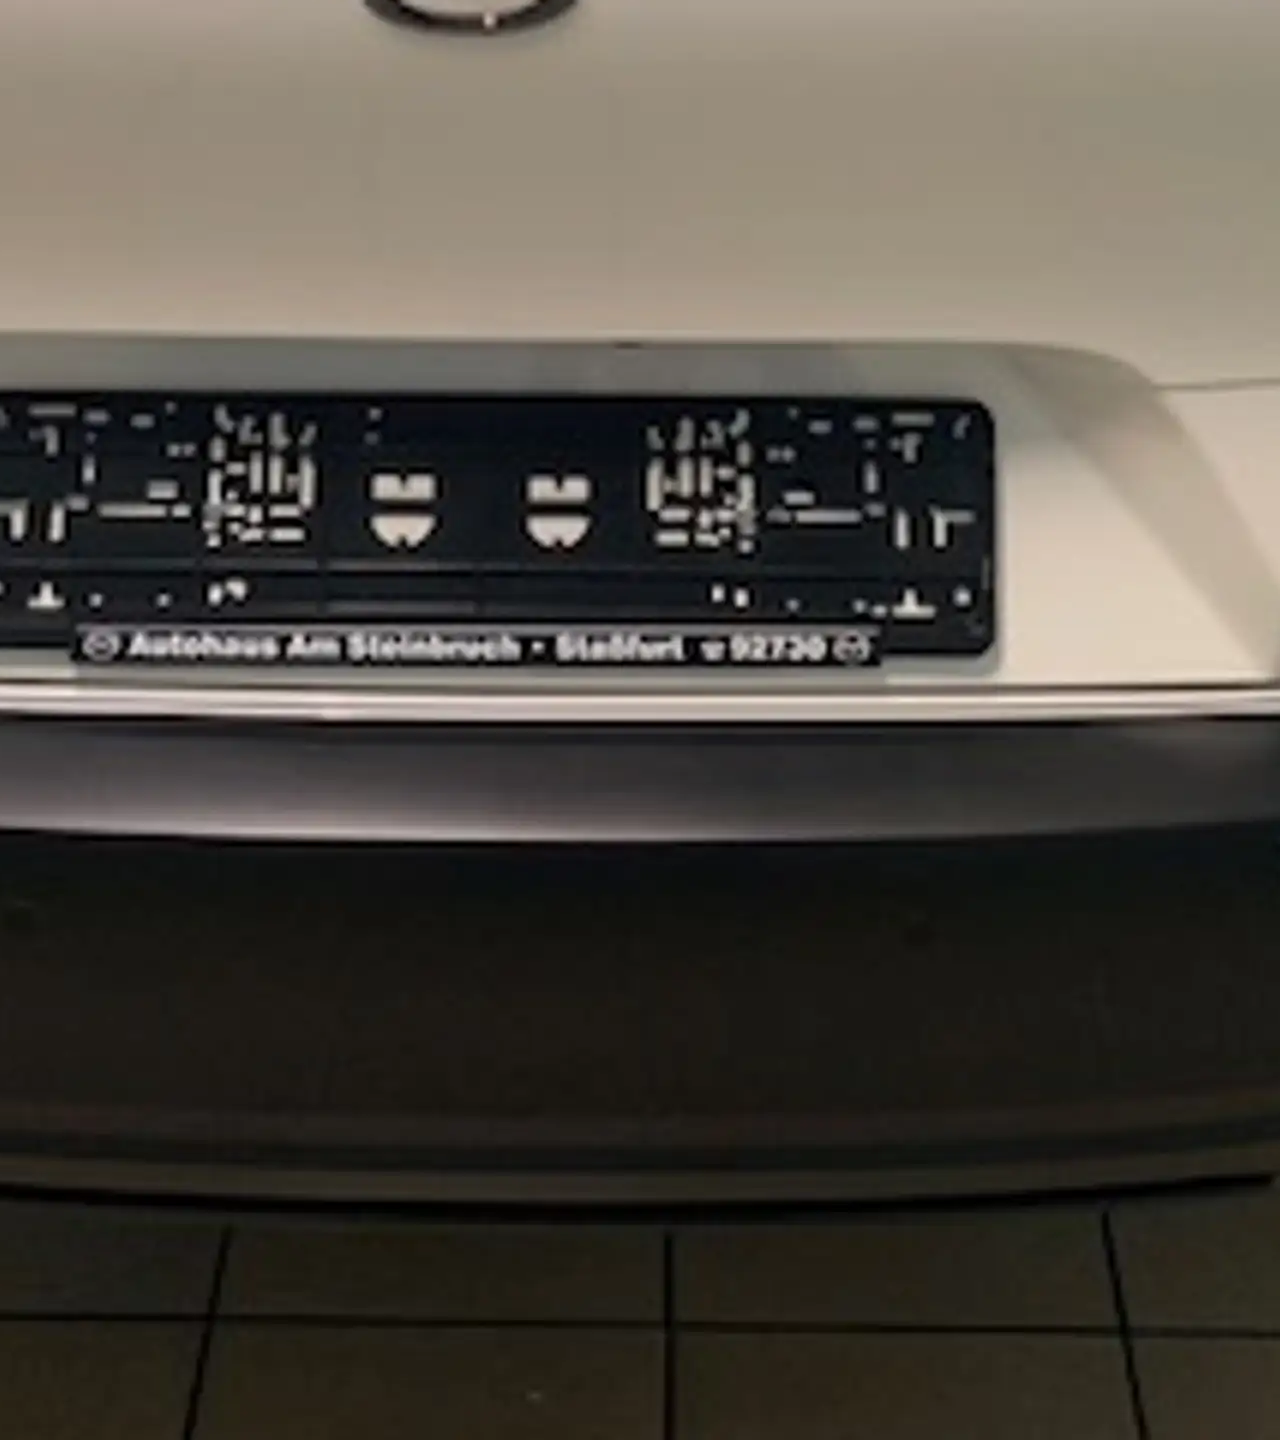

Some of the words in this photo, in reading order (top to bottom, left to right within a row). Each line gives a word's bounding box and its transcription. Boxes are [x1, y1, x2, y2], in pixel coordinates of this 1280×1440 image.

[127, 631, 281, 658] Autohaus
[286, 631, 341, 660] Am
[347, 632, 521, 661] Steinbruch
